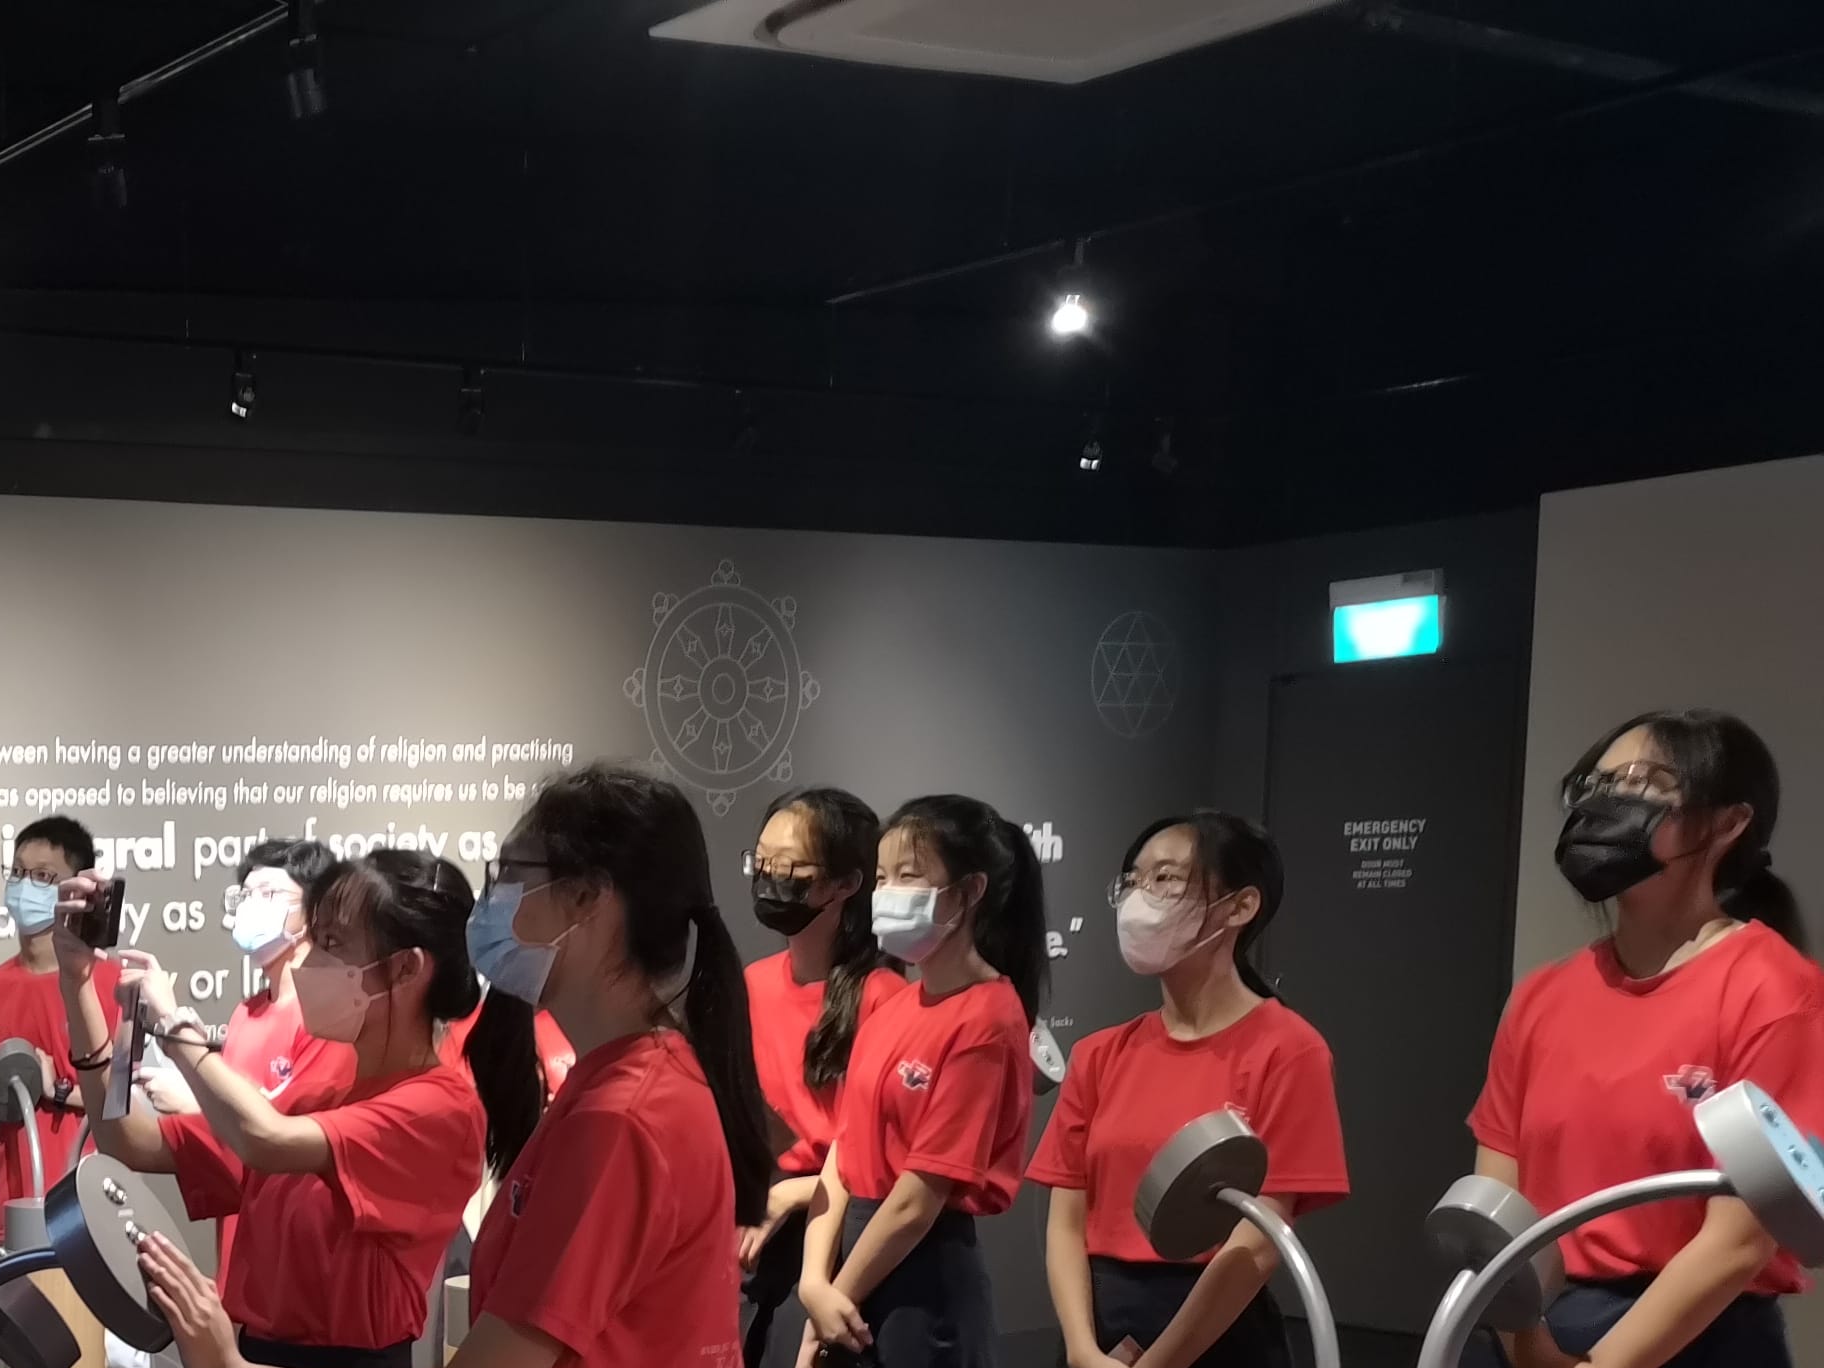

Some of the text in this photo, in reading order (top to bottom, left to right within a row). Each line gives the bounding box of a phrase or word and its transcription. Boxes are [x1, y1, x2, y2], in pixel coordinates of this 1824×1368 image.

[55, 736, 121, 770] having
[127, 745, 141, 763] a
[147, 741, 216, 770] greater
[222, 735, 352, 769] understanding
[356, 735, 376, 763] of
[380, 735, 447, 769] religion
[452, 735, 486, 762] and
[491, 738, 573, 769] practising
[24, 778, 111, 814] opposed
[117, 783, 136, 805] to
[142, 778, 227, 811] believing
[233, 777, 269, 804] that
[273, 785, 305, 804] our
[309, 776, 377, 809] religion
[382, 778, 454, 809] requires
[458, 783, 477, 802] us
[481, 779, 499, 801] to
[503, 774, 526, 801] be
[1343, 819, 1426, 836] EMERGENCY
[458, 830, 498, 861] as
[1350, 836, 1418, 852] EXIT ONLY
[162, 900, 206, 931] as
[190, 969, 230, 999] or
